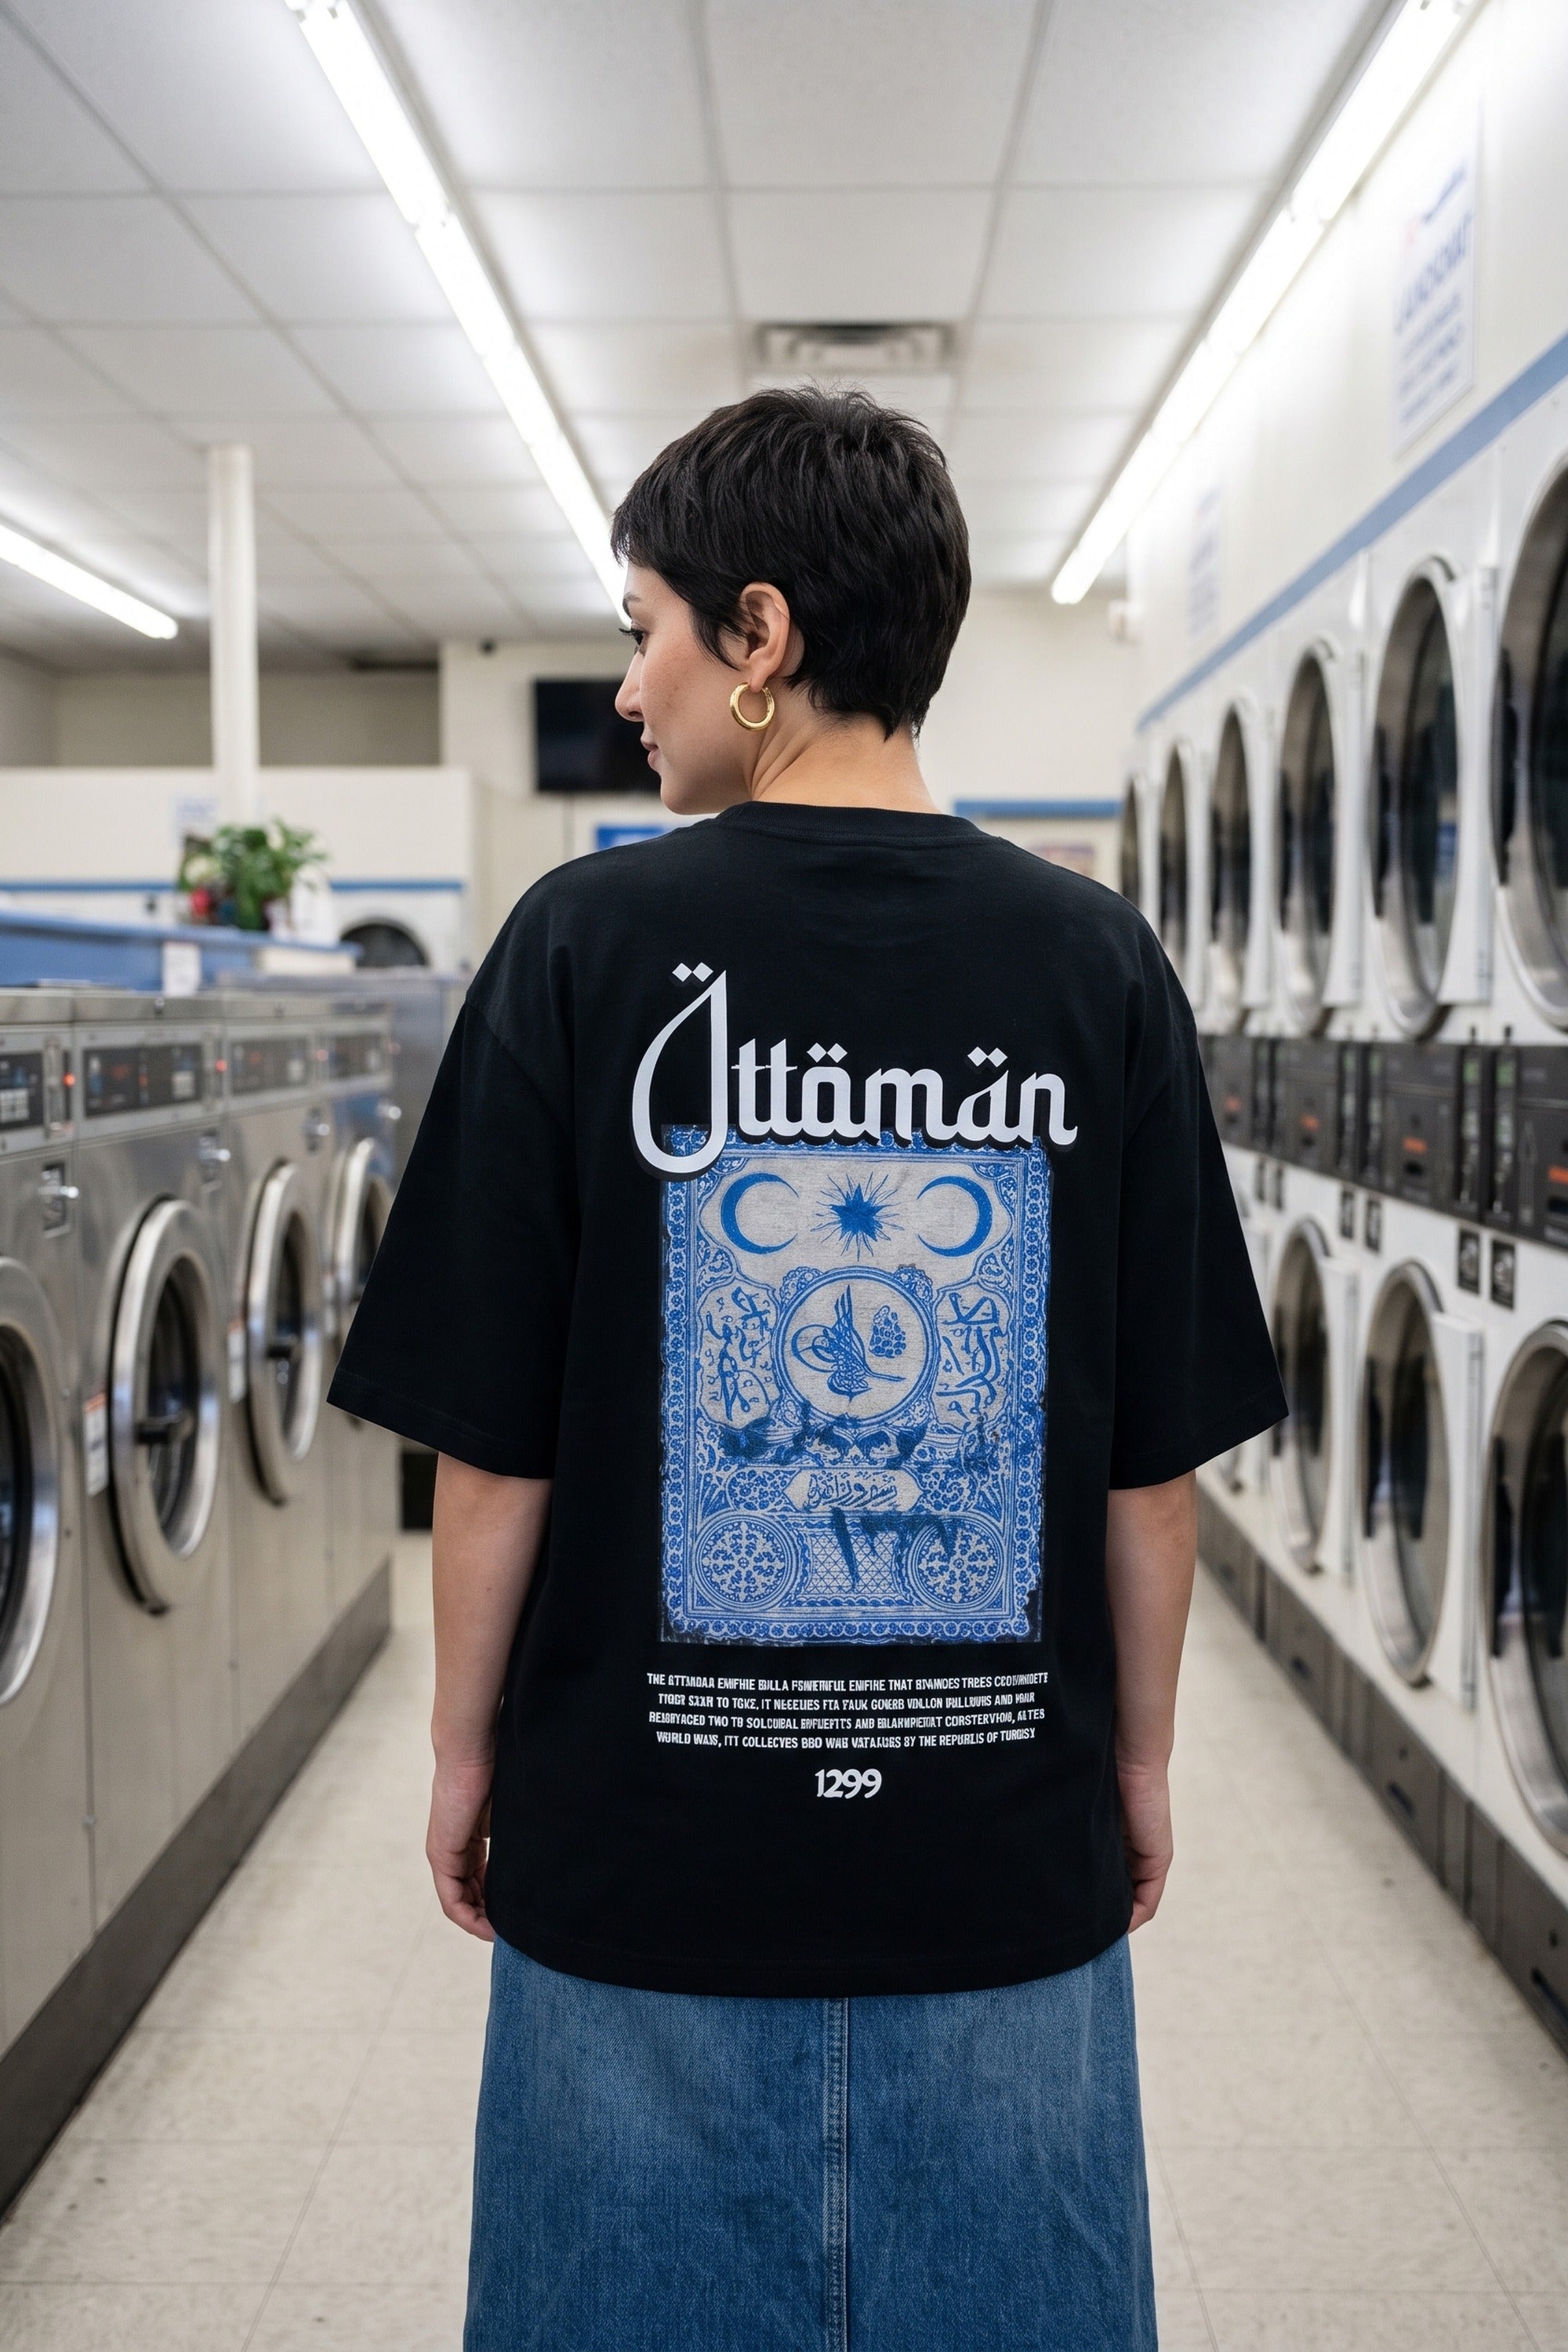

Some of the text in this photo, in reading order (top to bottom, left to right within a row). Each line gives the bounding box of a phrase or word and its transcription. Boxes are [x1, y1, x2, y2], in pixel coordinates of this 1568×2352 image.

[647, 1673, 666, 1685] THE
[717, 1697, 729, 1708] TO
[762, 1699, 771, 1709] IT
[987, 1732, 999, 1743] OF
[815, 1768, 882, 1799] 1299
